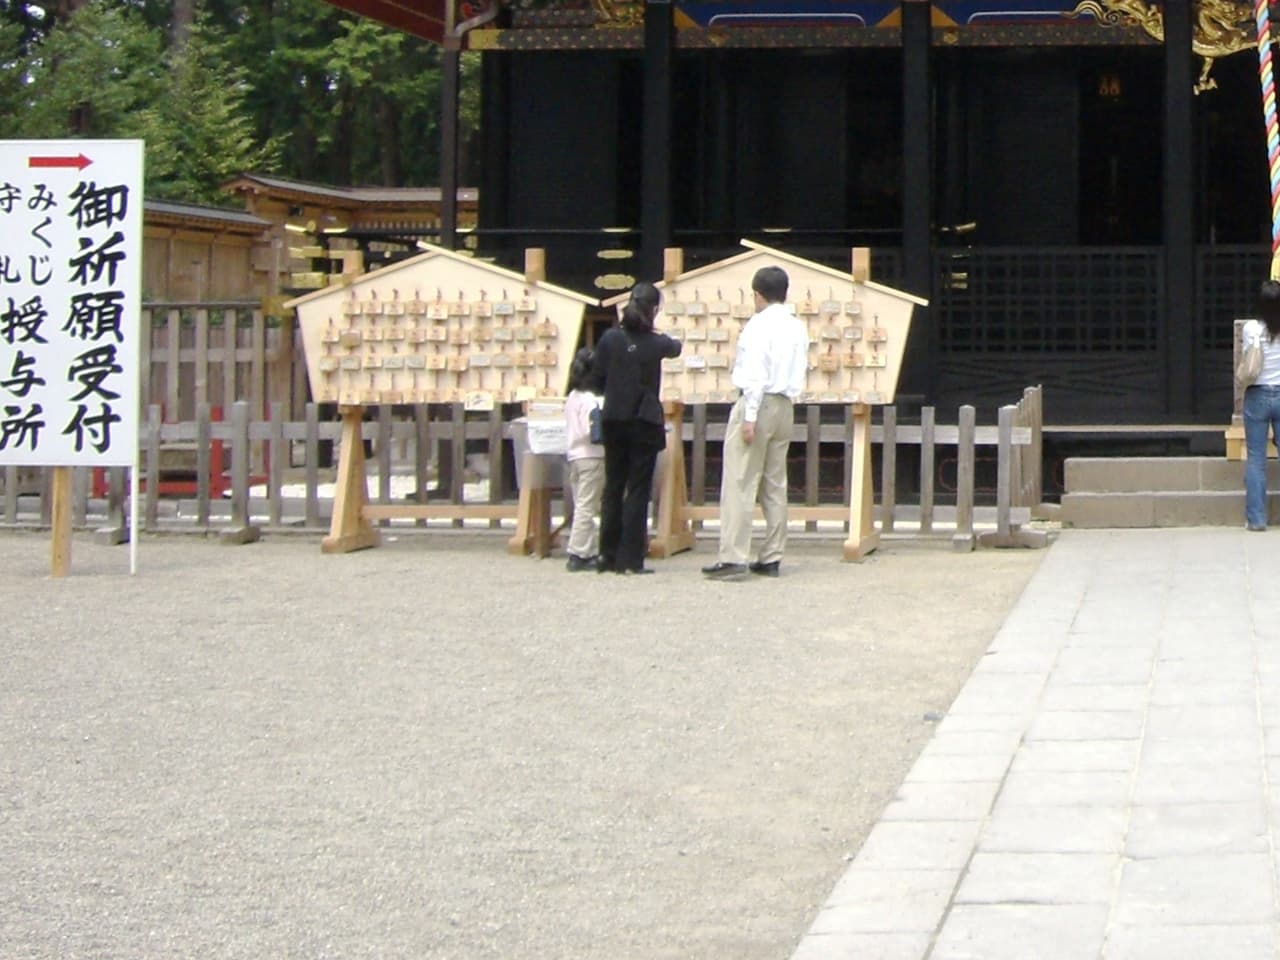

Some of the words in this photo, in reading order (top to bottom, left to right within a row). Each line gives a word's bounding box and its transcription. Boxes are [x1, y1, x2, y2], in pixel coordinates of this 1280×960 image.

[62, 181, 129, 454] 御祈願受付
